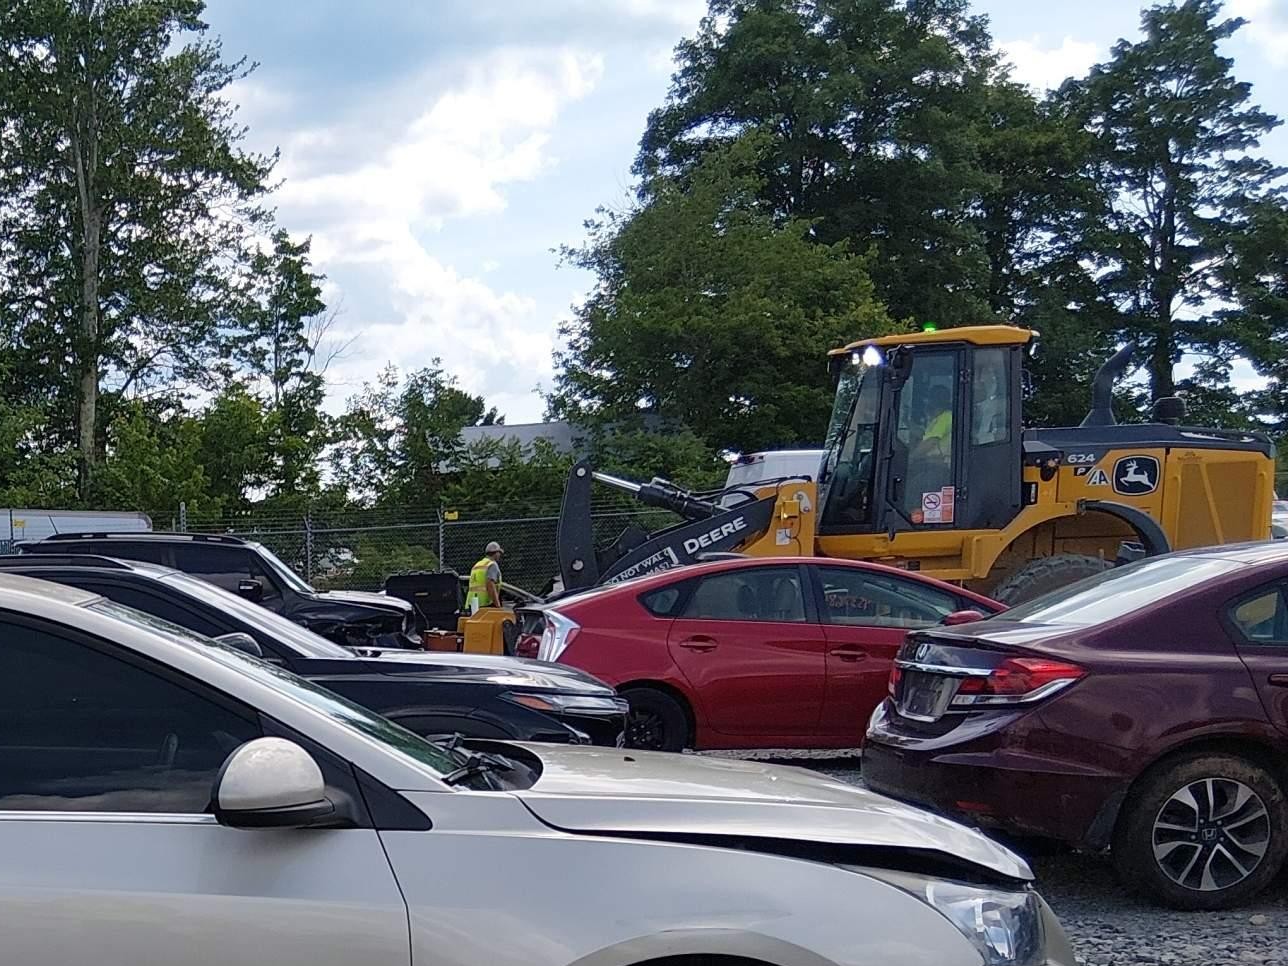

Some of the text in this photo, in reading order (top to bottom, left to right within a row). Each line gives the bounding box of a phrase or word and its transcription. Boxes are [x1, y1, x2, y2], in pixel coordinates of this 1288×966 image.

[1067, 453, 1096, 464] 624
[1076, 467, 1087, 476] P
[683, 516, 748, 555] DEERE
[620, 562, 642, 580] NOT
